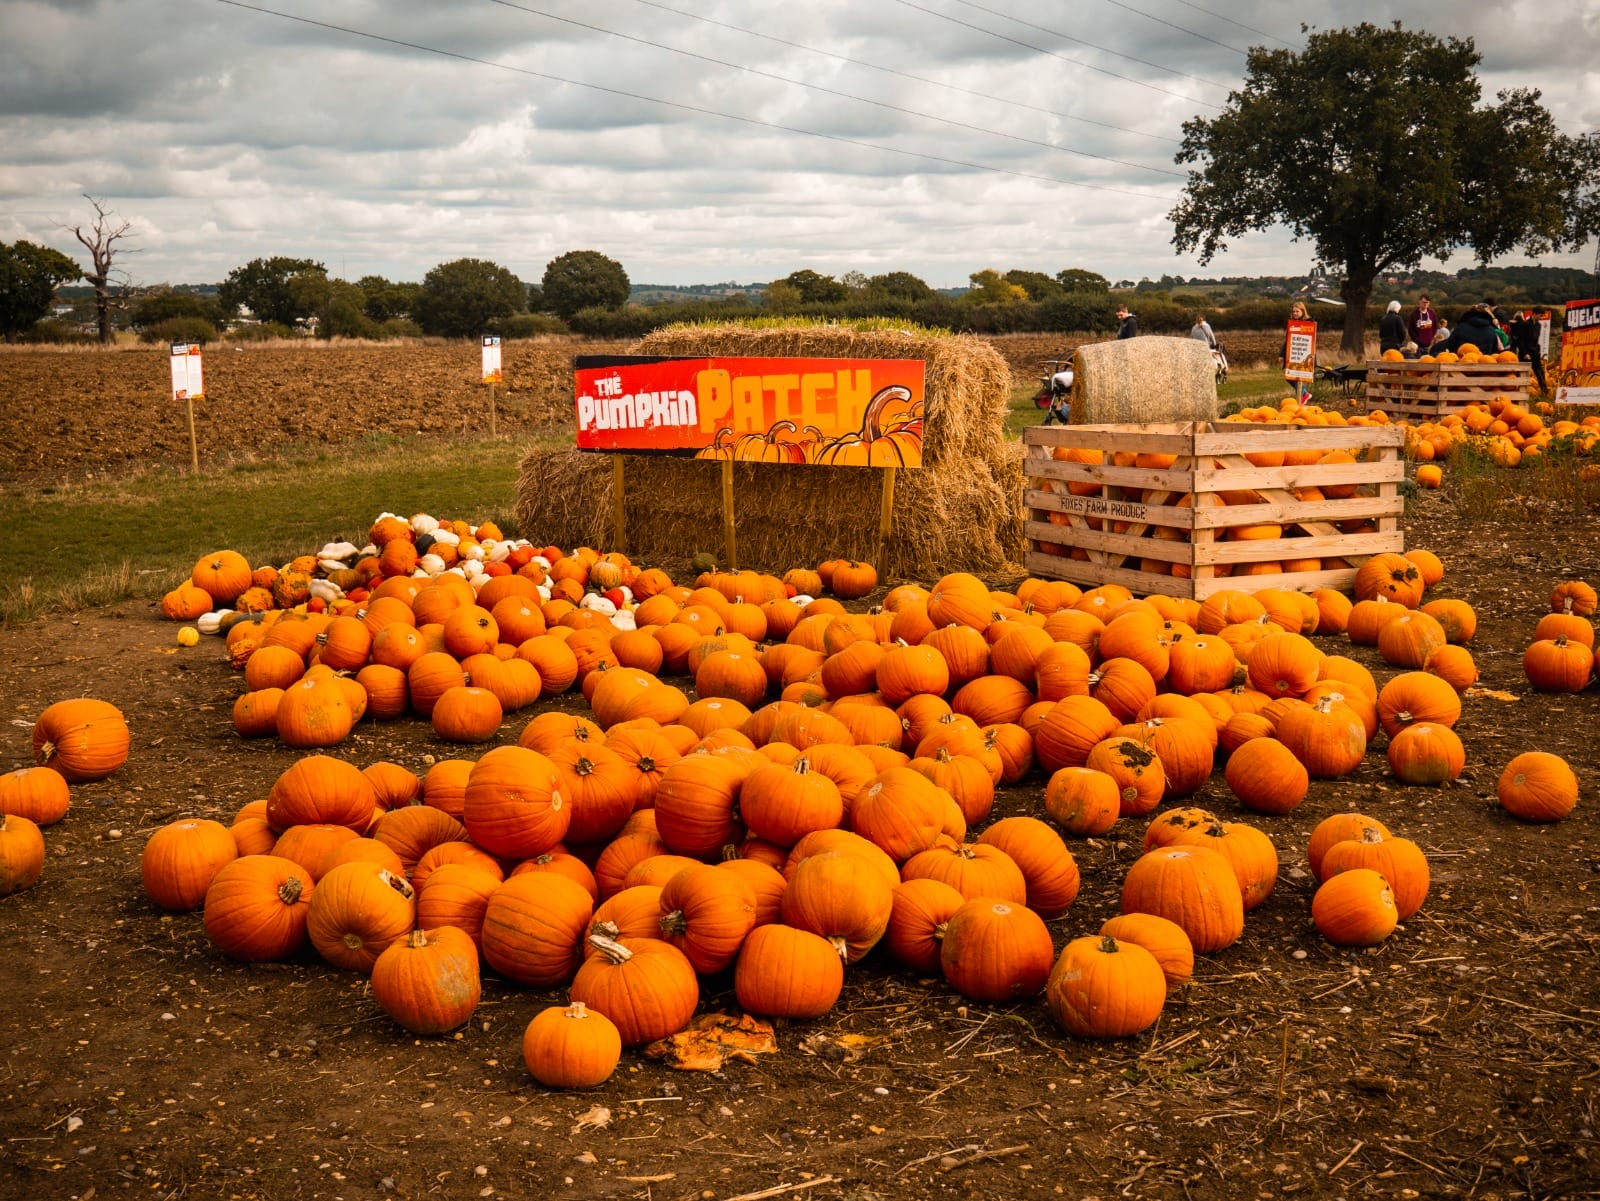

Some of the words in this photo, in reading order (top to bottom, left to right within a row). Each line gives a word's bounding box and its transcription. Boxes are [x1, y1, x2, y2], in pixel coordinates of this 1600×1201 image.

[594, 376, 623, 396] THE
[695, 368, 872, 434] PATCH
[1060, 496, 1083, 512] FOXES
[1086, 499, 1107, 515] FARM
[1110, 503, 1146, 520] PRODUCE
